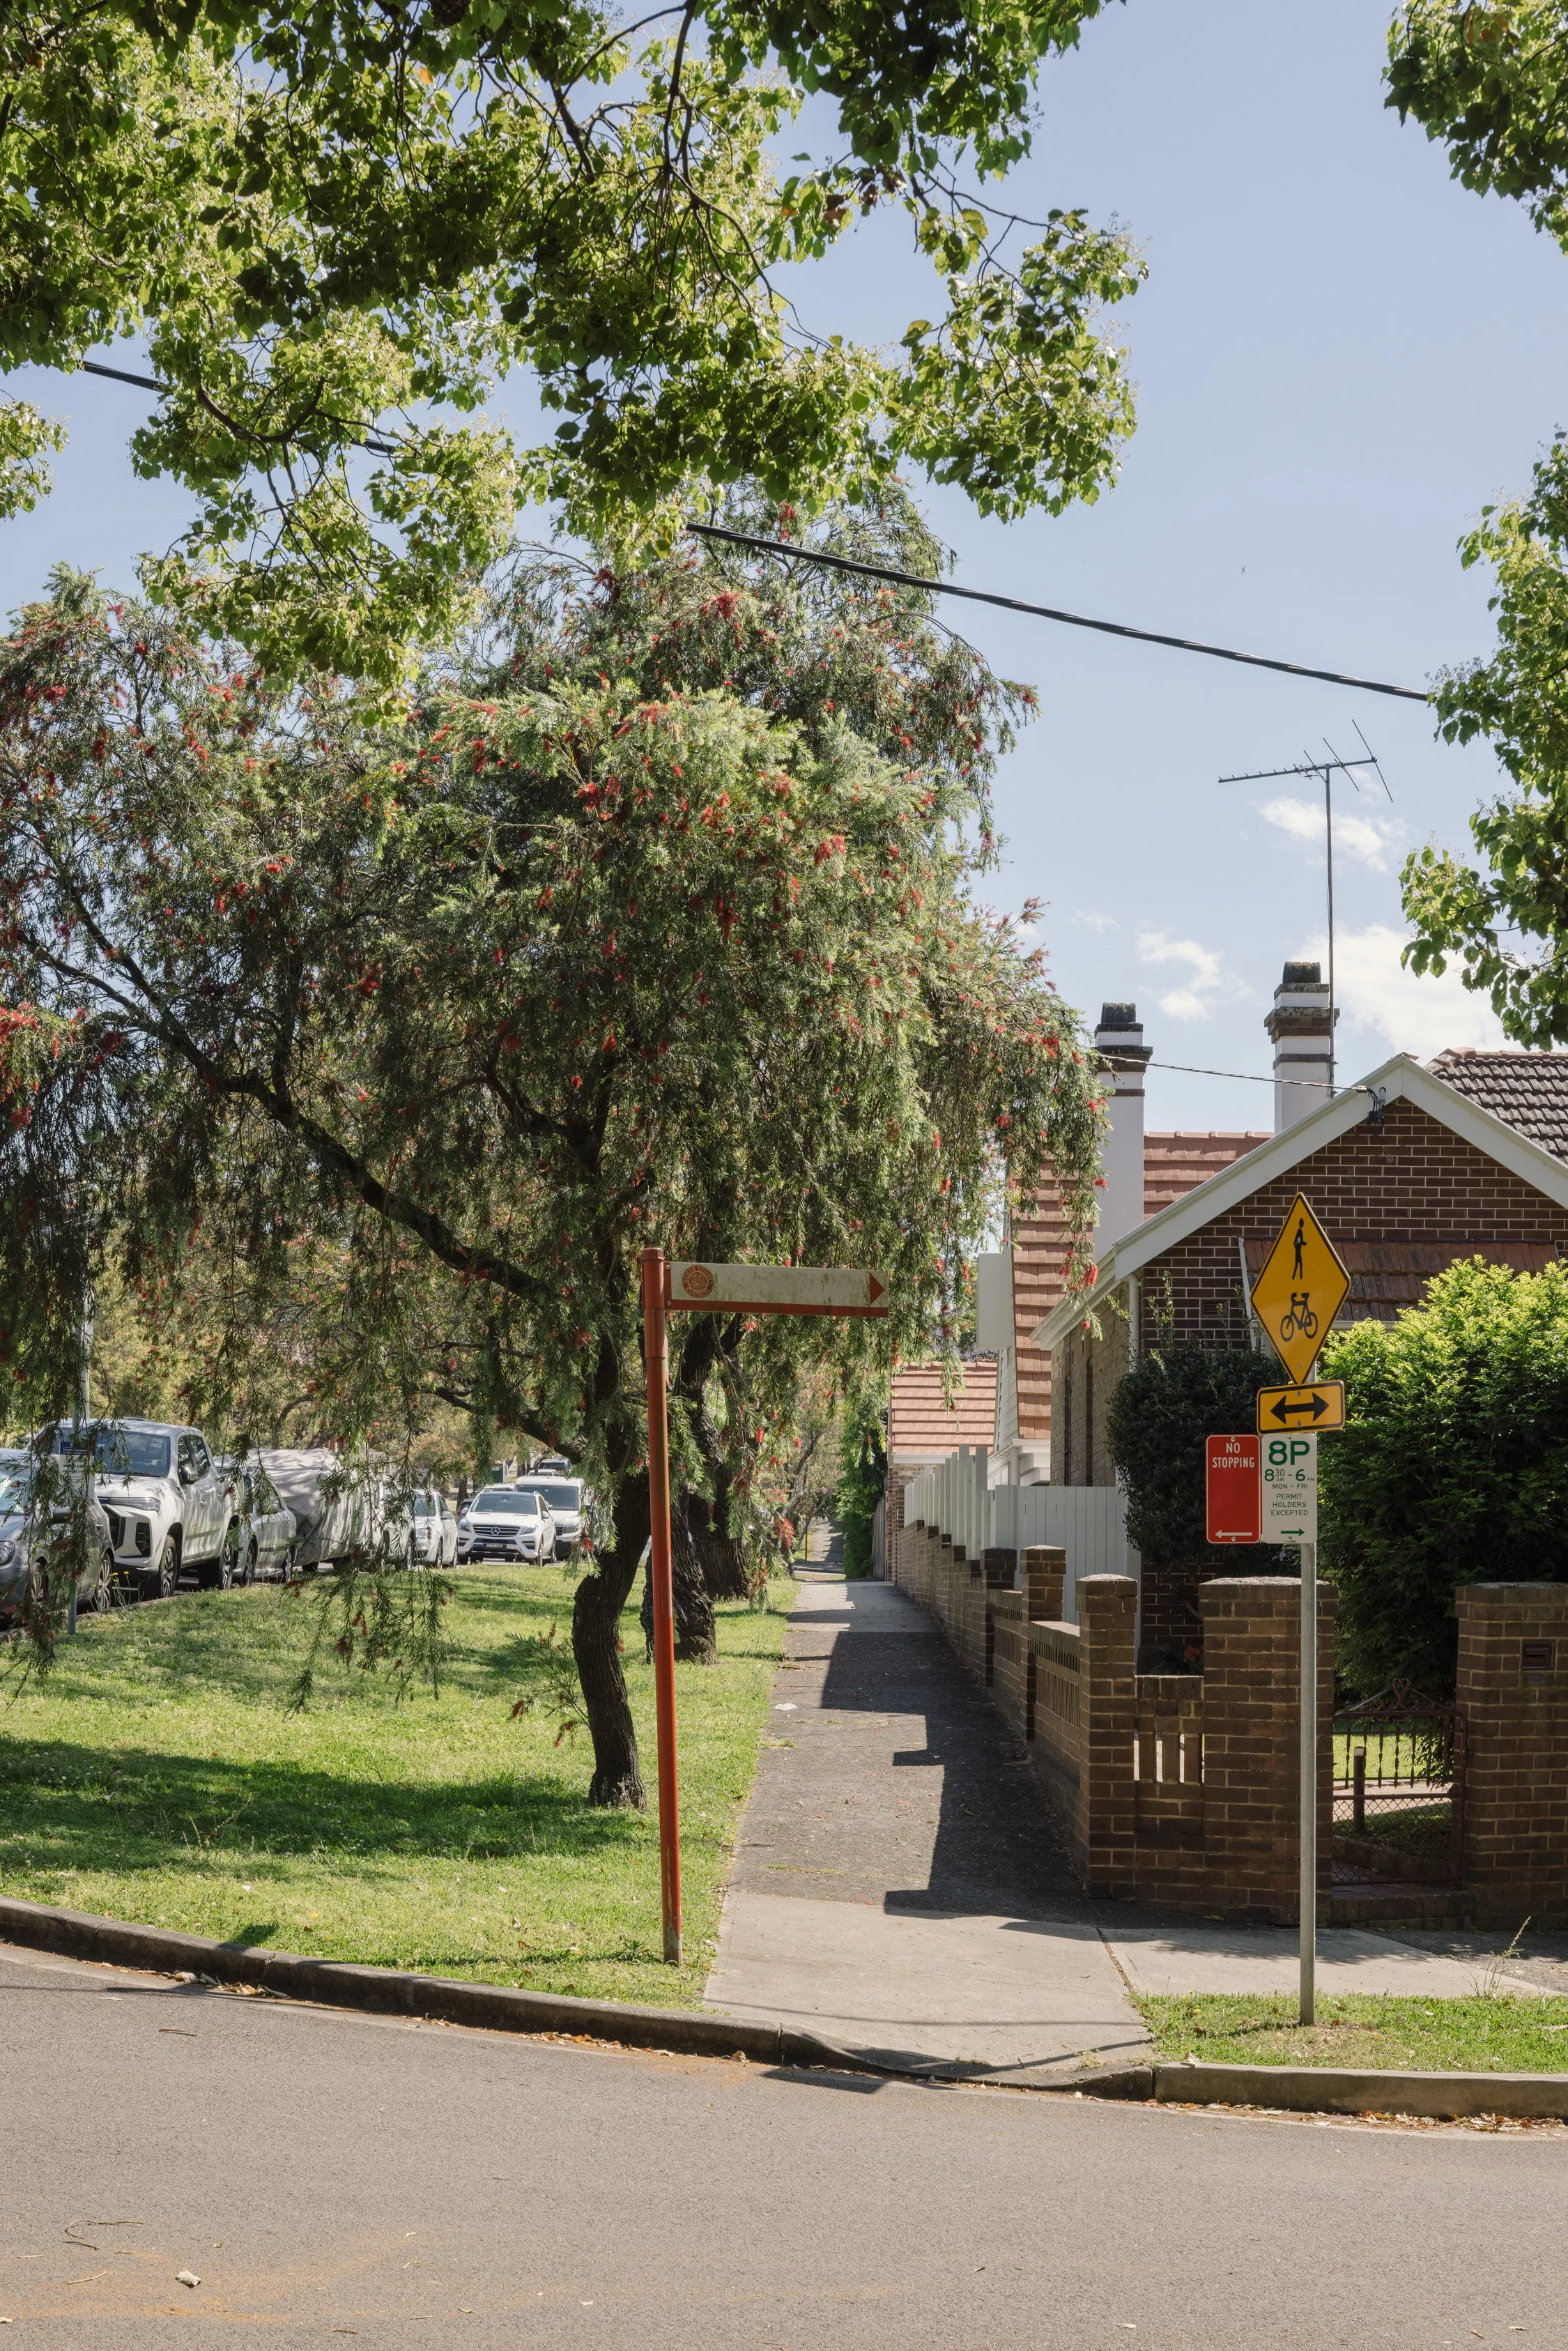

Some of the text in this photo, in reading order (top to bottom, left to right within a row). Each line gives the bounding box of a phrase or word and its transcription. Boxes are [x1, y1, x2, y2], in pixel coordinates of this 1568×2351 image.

[684, 1266, 713, 1284] NORTH SYDNEY
[686, 1287, 709, 1297] COUNCIL
[1226, 1443, 1240, 1453] NO
[1268, 1441, 1310, 1466] 8P
[1213, 1457, 1254, 1469] STOPPING
[1296, 1469, 1305, 1482] 6
